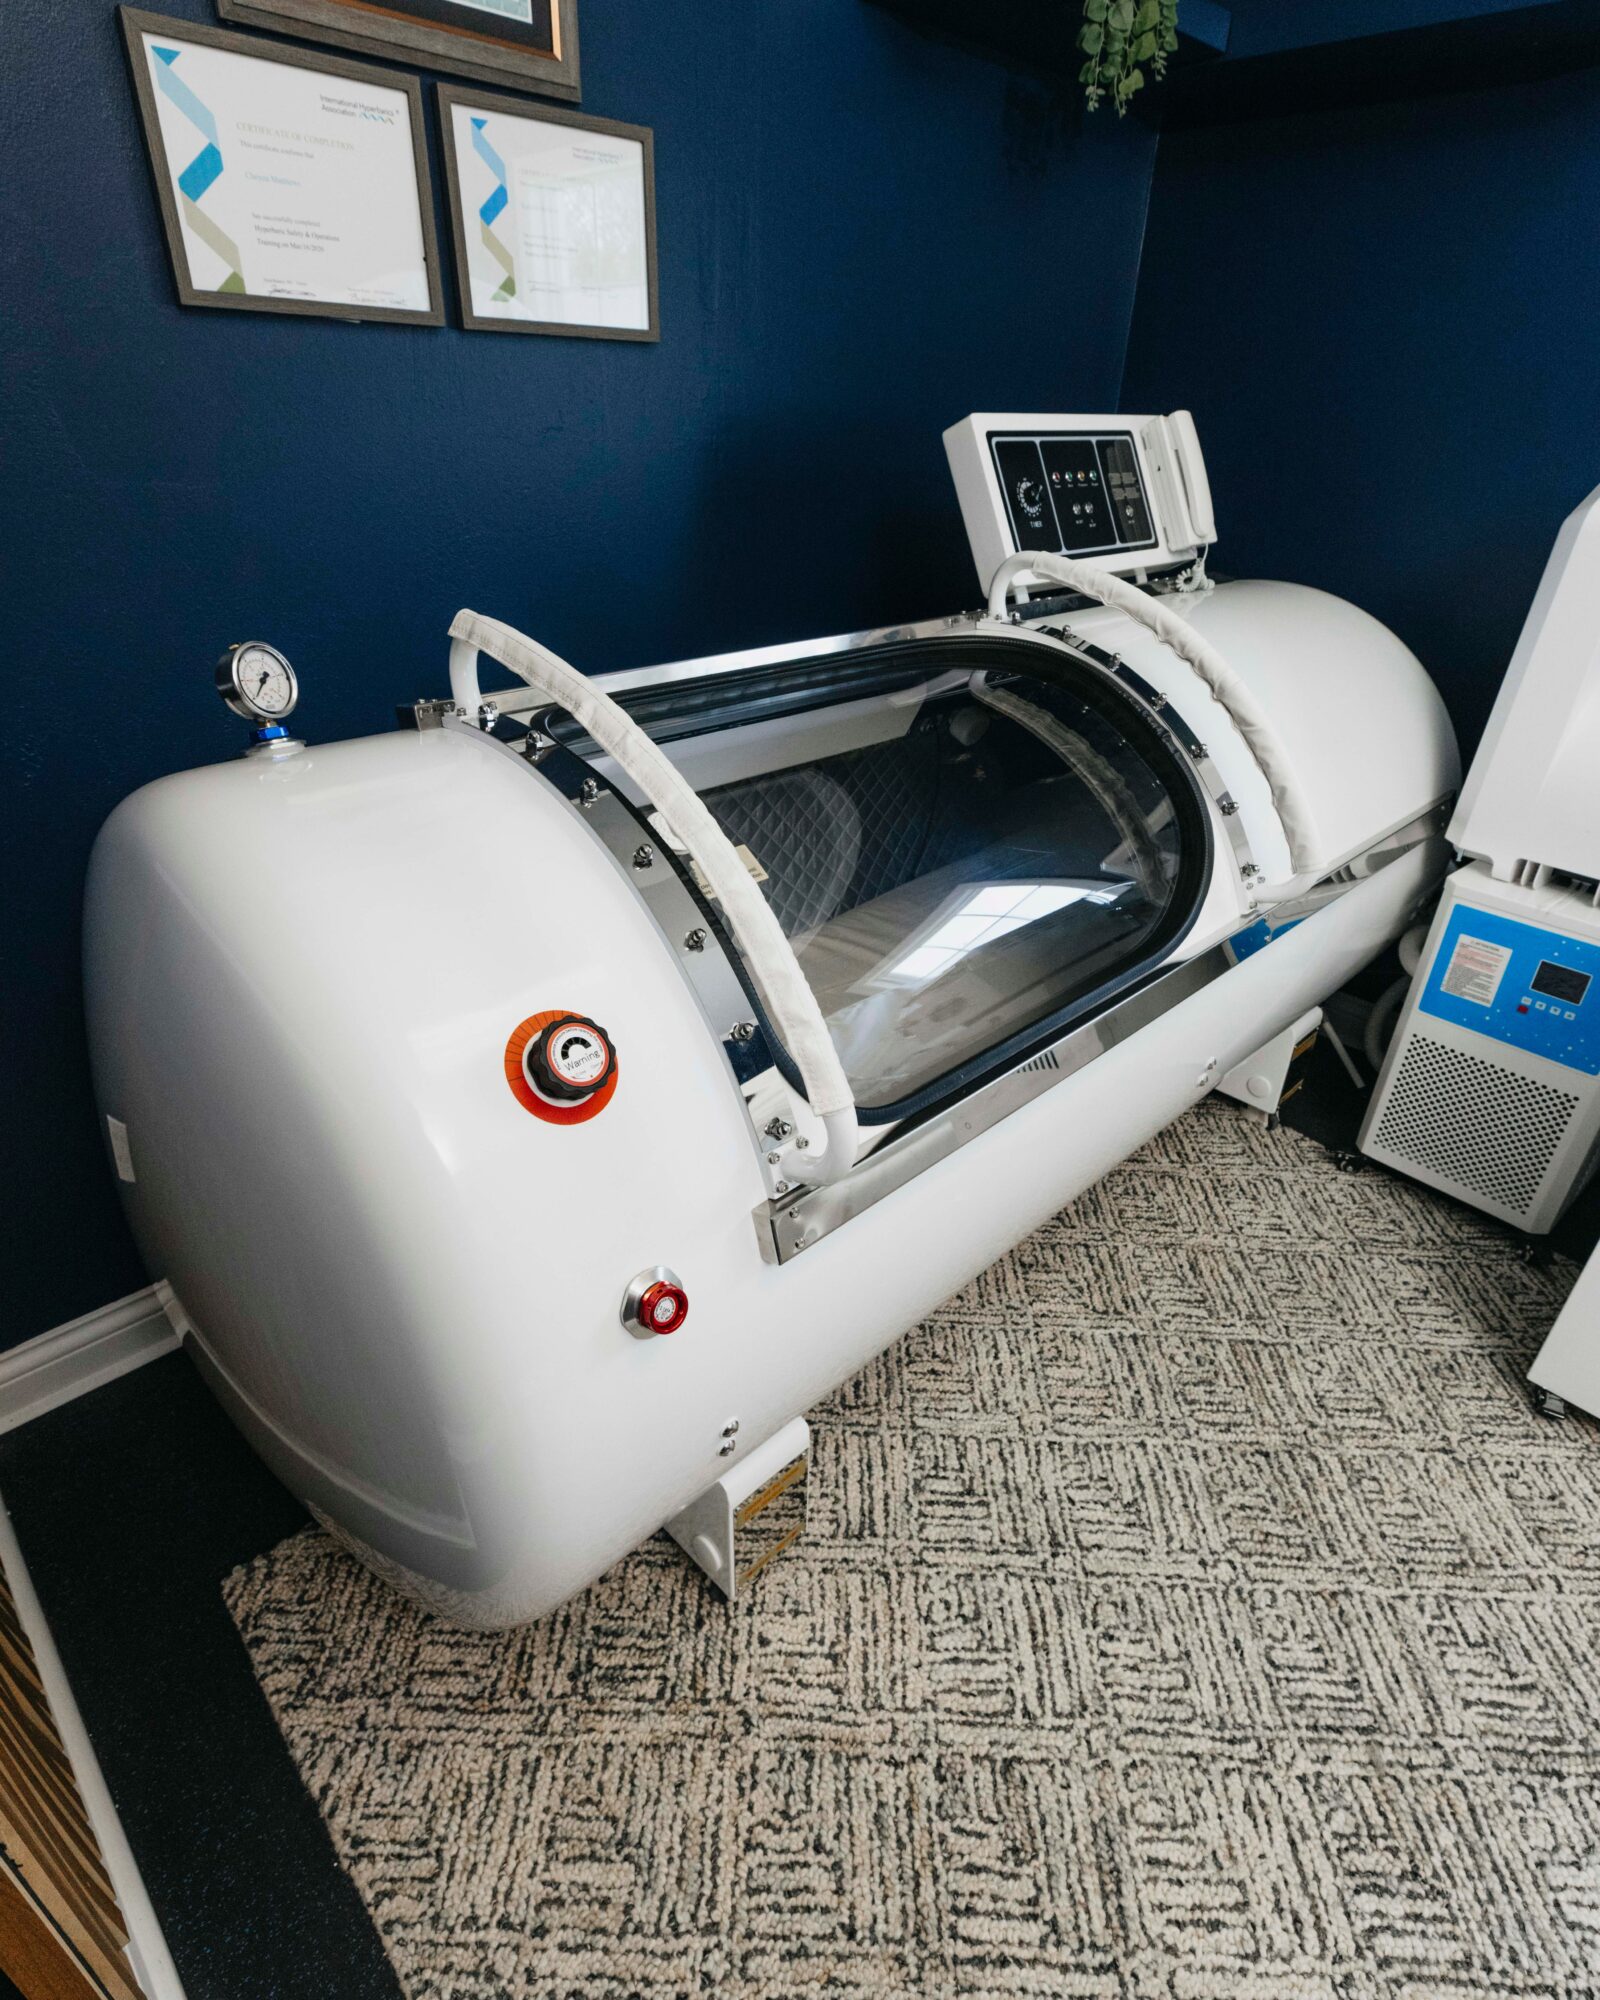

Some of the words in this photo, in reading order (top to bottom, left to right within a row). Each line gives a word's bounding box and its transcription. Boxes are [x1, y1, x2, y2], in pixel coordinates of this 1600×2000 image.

[319, 94, 358, 108] International
[321, 104, 356, 117] Association
[236, 121, 290, 138] CERTIFICATE
[290, 131, 301, 141] OF
[303, 134, 354, 151] COMPLETION
[564, 1050, 601, 1071] Warning
